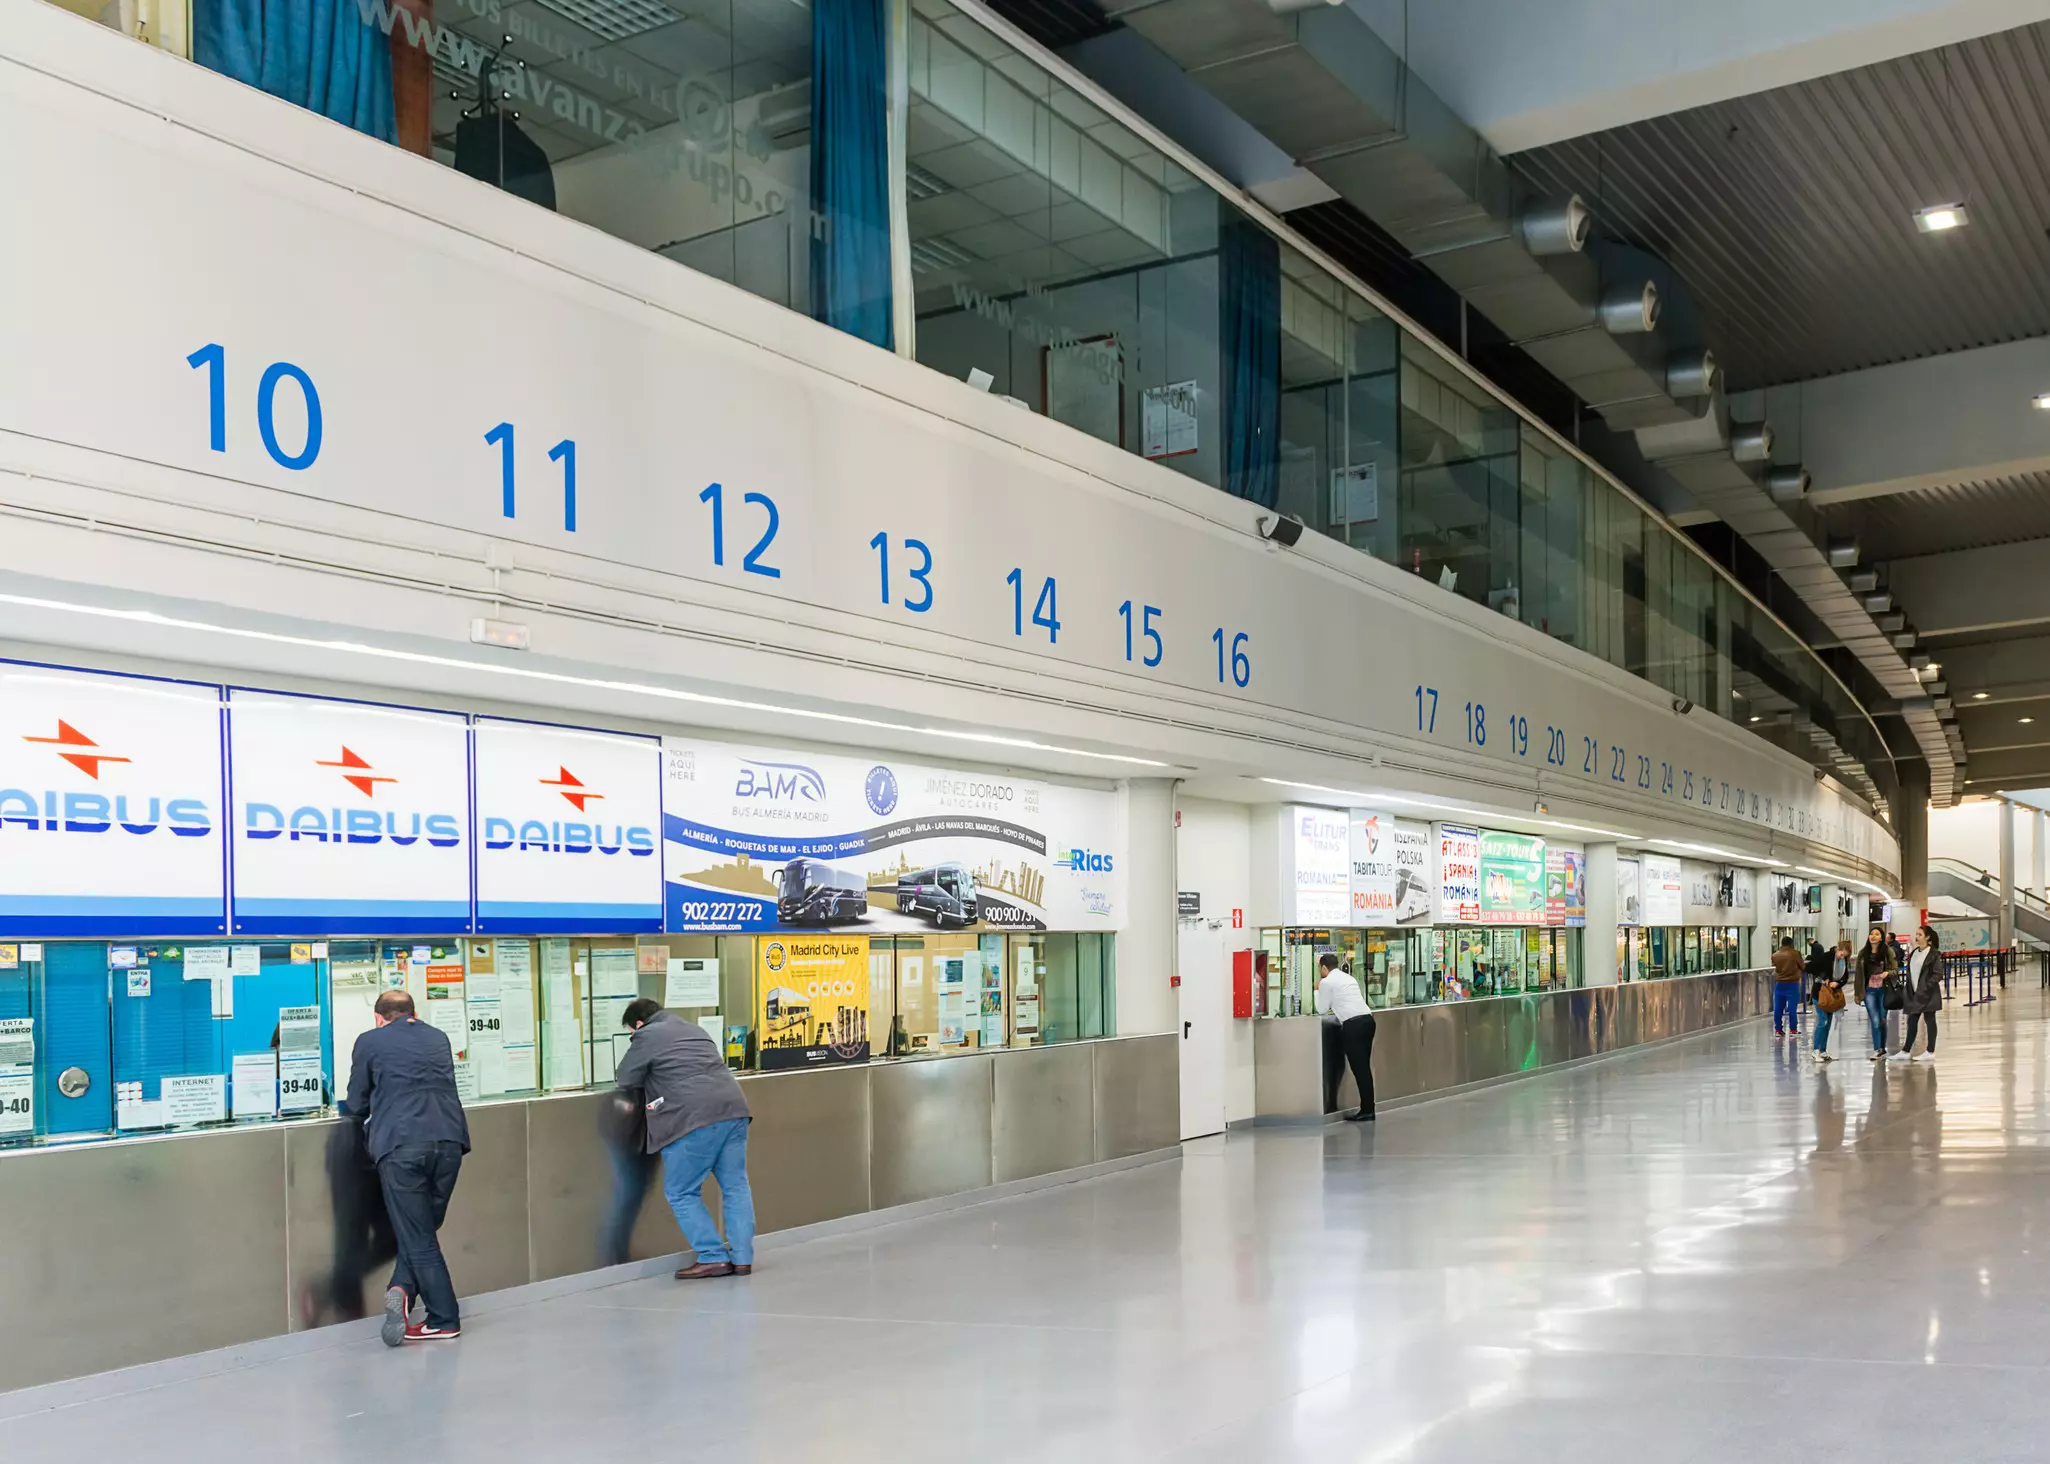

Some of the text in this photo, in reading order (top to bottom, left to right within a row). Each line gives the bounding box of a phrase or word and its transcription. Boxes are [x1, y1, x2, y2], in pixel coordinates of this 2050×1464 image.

[186, 343, 322, 470] 10
[484, 422, 576, 532] 11
[699, 482, 780, 578] 12
[870, 532, 933, 612] 13
[1007, 567, 1061, 643] 14
[1119, 600, 1163, 667] 15
[1213, 628, 1250, 688] 16
[1416, 685, 1438, 733] 17
[1465, 702, 1486, 746] 18
[1509, 714, 1528, 756] 19
[1547, 726, 1565, 766] 20
[1584, 736, 1597, 774] 21
[1611, 746, 1625, 782] 22
[669, 771, 695, 781] HERE
[736, 769, 797, 800] BAM
[1638, 755, 1650, 789] 23
[1662, 762, 1673, 795] 24
[1683, 769, 1693, 800] 25
[923, 775, 1013, 801] JIMÉNEZ DORADO
[1703, 776, 1712, 806] 26
[1721, 782, 1729, 811] 27
[1737, 788, 1745, 815] 28
[732, 807, 750, 818] BUS
[794, 811, 829, 822] MADRID
[940, 798, 998, 811] AUTOCARES
[1751, 793, 1759, 819] 29
[1765, 797, 1772, 823] 30
[246, 802, 460, 848] DAIBUS
[485, 817, 654, 857] DAIBUS
[888, 826, 911, 839] MADRID
[915, 823, 931, 833] ÁVILA
[934, 822, 945, 830] LAS
[946, 822, 963, 830] NAVAS
[965, 822, 975, 830] DEL
[1003, 828, 1017, 838] HOYO
[1018, 831, 1025, 840] DE
[1026, 834, 1045, 849] PINARES
[1301, 816, 1347, 841] ELITUR
[682, 828, 865, 854] ALMERÍA ROQUETAS DE MAR EL EJIDO GUADIX
[1314, 841, 1340, 852] TRANS
[1397, 850, 1423, 865] POLSKA
[682, 902, 762, 920] 902 227 272
[985, 907, 1003, 922] 900
[1003, 907, 1020, 922] 900
[790, 944, 859, 957] Madrid City Live
[469, 1018, 500, 1032] 39-40
[172, 1078, 214, 1087] INTERNET
[282, 1078, 319, 1094] 39-40
